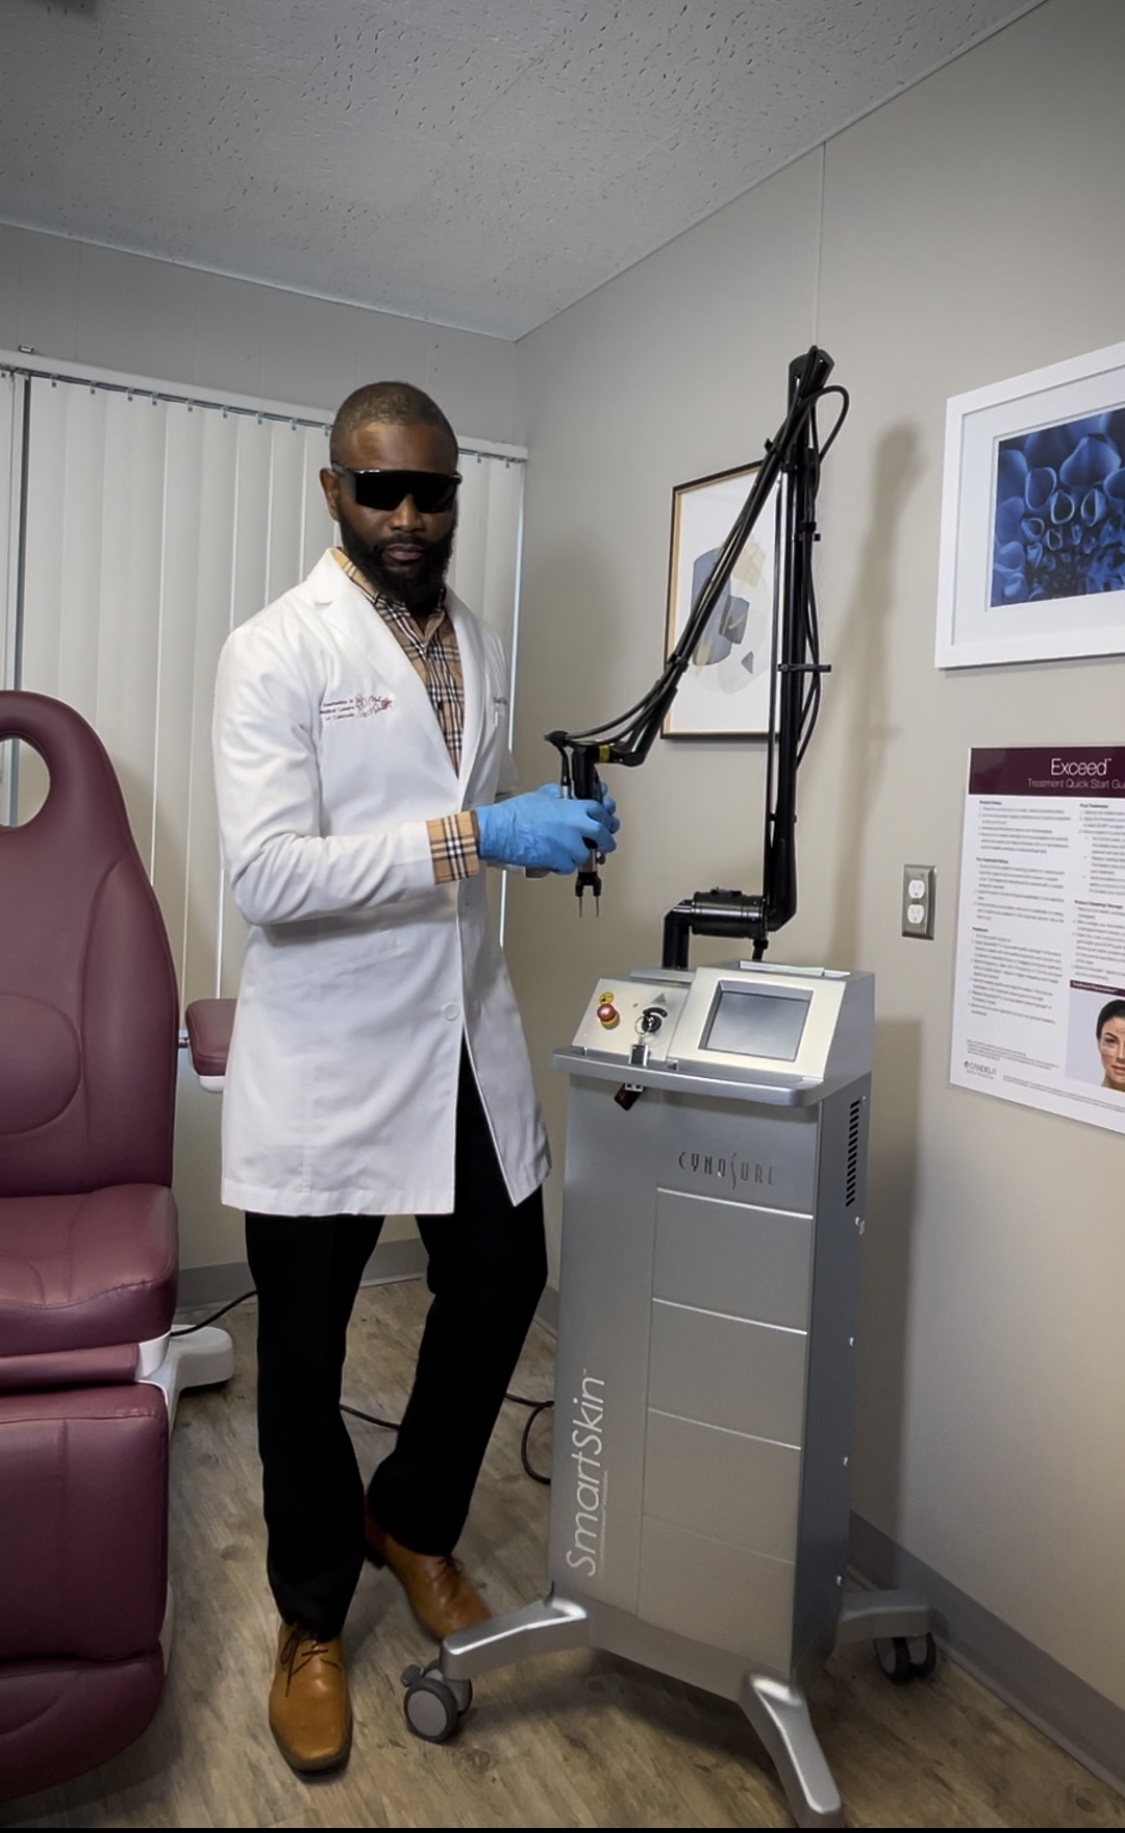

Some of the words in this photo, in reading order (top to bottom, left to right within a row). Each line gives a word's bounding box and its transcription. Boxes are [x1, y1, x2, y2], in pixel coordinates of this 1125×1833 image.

[1027, 778, 1064, 788] Treatment
[1065, 778, 1089, 789] Quick
[1090, 779, 1110, 789] Start
[678, 1151, 775, 1189] CYNOSURE
